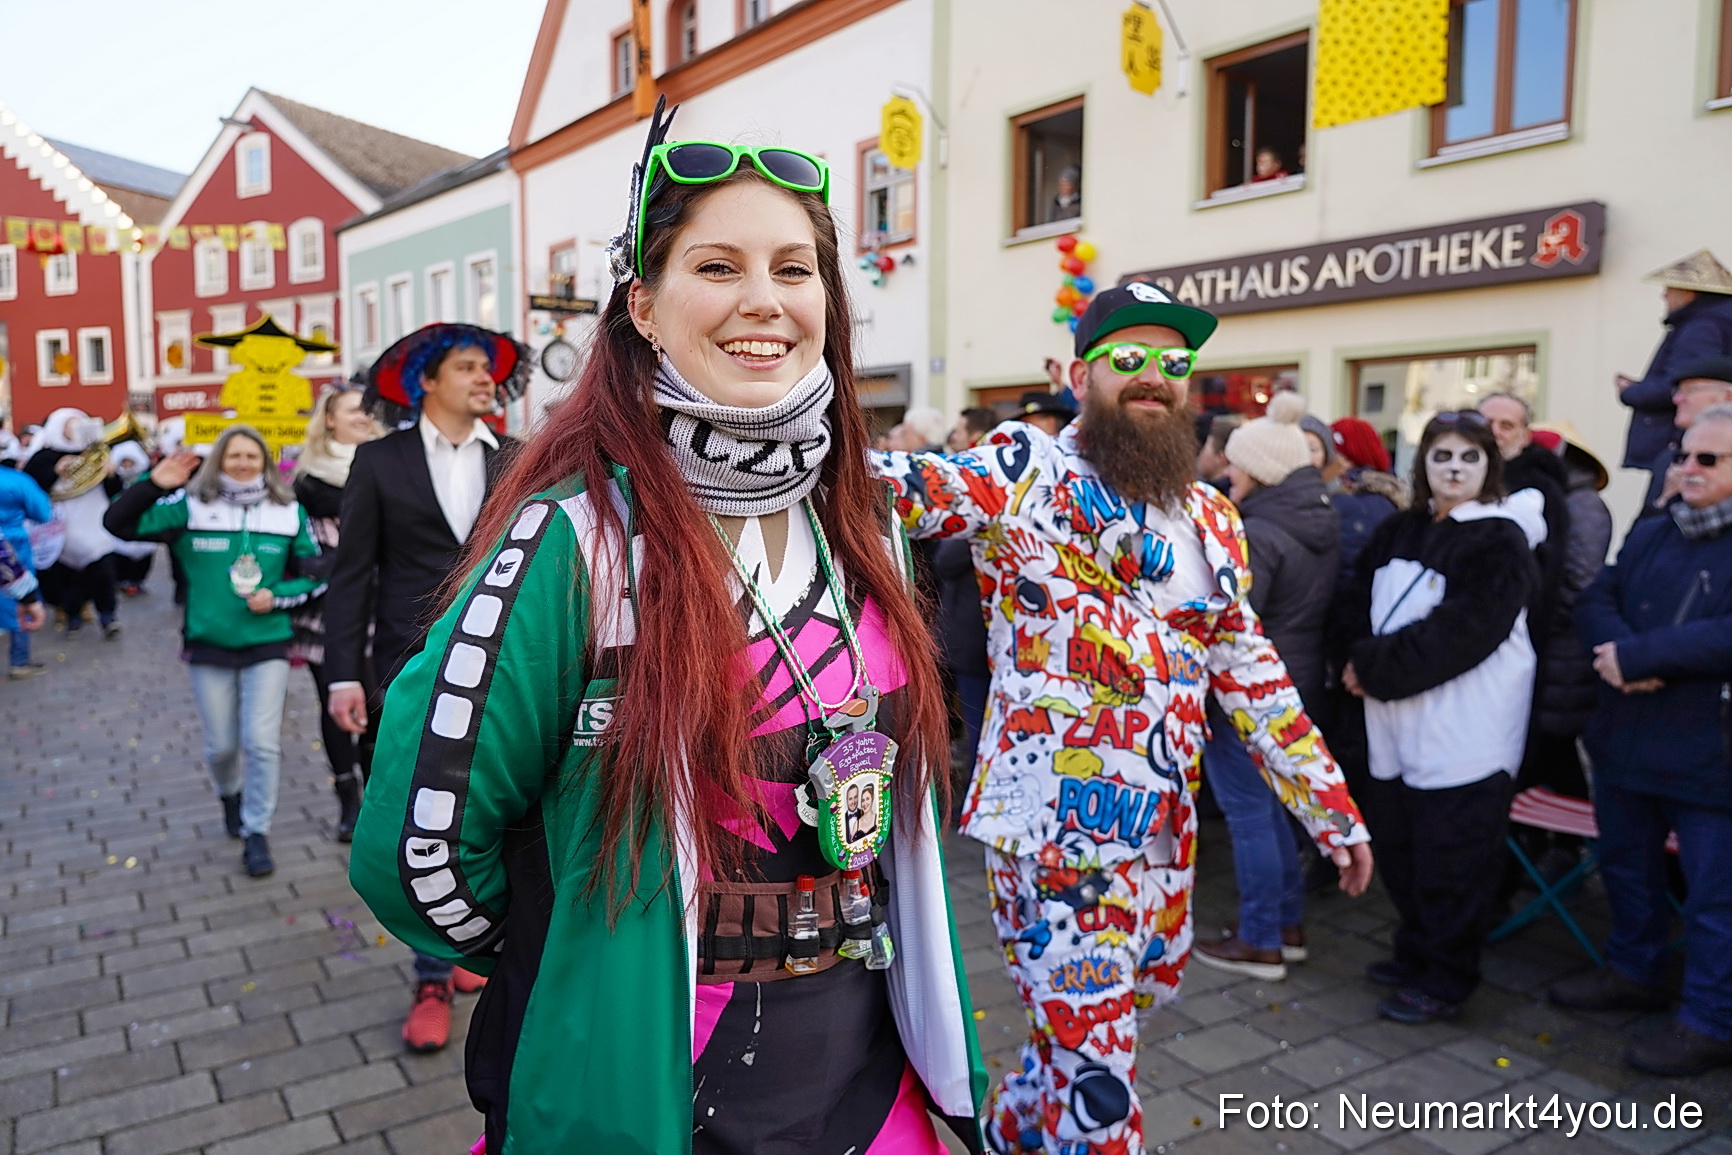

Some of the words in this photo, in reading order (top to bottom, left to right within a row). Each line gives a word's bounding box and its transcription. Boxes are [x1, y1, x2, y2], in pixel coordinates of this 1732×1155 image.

[1313, 223, 1527, 290] APOTHEKE
[1062, 707, 1150, 749] ZAP
[842, 741, 854, 756] 35
[1056, 777, 1161, 849] POW!
[852, 854, 869, 867] 2023
[1050, 959, 1124, 992] CRACK
